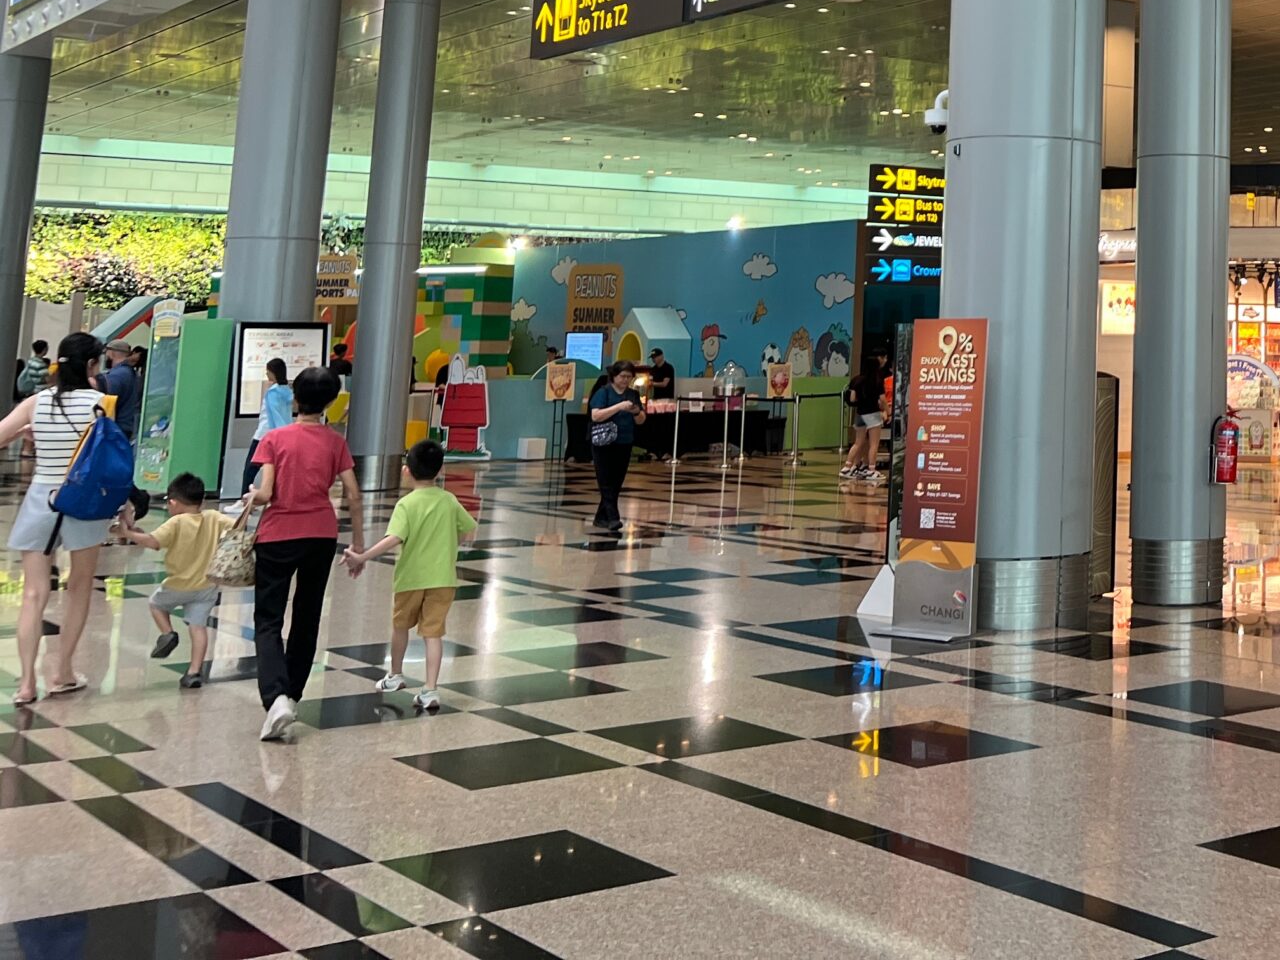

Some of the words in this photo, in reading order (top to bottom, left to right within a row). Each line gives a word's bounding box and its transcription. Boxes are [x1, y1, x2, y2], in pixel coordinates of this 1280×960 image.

[578, 17, 591, 36] to
[592, 10, 605, 32] T1
[613, 3, 628, 27] T2
[916, 199, 932, 211] Bus
[933, 200, 944, 211] to
[916, 212, 926, 222] (at
[926, 212, 938, 223] T2)
[914, 235, 943, 247] JEWEL
[575, 274, 617, 298] PEANUTS
[346, 288, 359, 297] PA
[573, 307, 615, 323] SUMMER
[920, 356, 942, 365] ENJOY
[951, 353, 977, 368] GST
[919, 367, 976, 383] SAVINGS
[930, 424, 946, 432] SHOP
[929, 452, 944, 460] SCAN
[927, 482, 941, 491] SAVE
[920, 604, 964, 620] CHANGI
